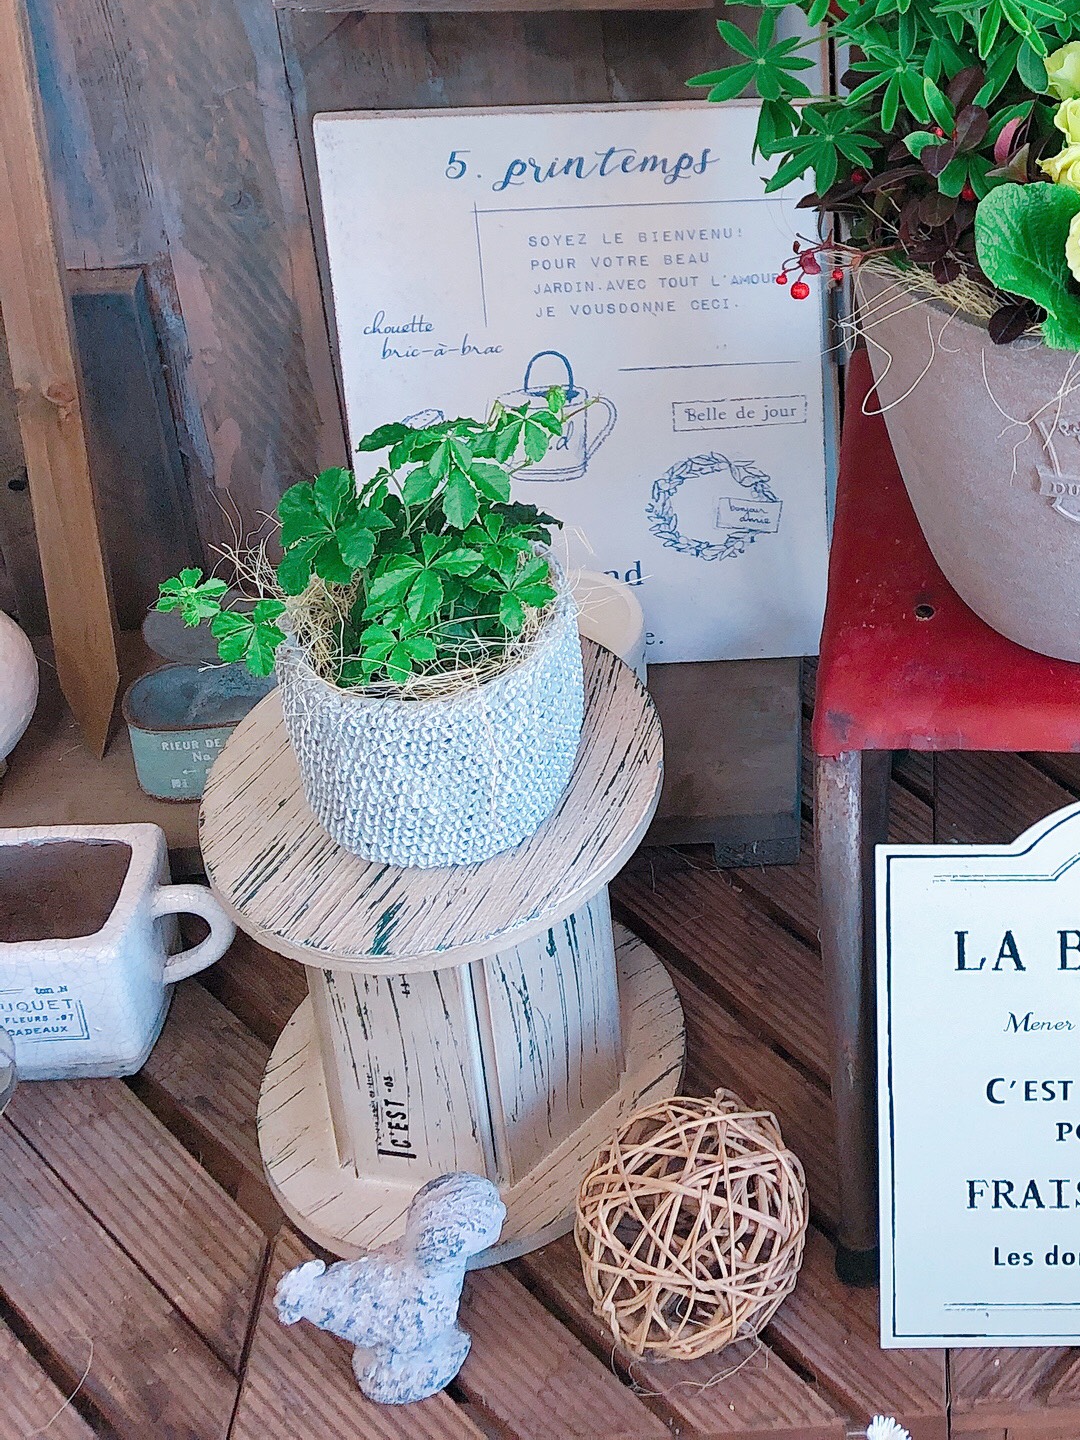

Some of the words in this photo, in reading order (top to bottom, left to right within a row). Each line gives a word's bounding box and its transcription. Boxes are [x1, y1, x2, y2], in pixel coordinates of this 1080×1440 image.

[492, 146, 720, 192] printemps
[528, 233, 587, 247] SOYEZ
[603, 233, 623, 244] LE
[638, 228, 743, 243] BIENVENU!
[531, 258, 576, 270] POUR
[591, 255, 649, 267] VOTRE
[664, 252, 709, 266] BEAU
[659, 276, 699, 288] TOUT
[536, 306, 556, 318] JE
[691, 297, 739, 310] CECI.
[363, 311, 435, 335] chouette
[684, 407, 727, 421] Belle
[736, 406, 755, 419] de
[762, 405, 797, 421] jour
[954, 930, 1026, 972] LA
[5, 1015, 48, 1024] FLEURS
[1003, 1012, 1075, 1034] Mener
[985, 1077, 1073, 1105] C'EST
[994, 1247, 1033, 1266] Les
